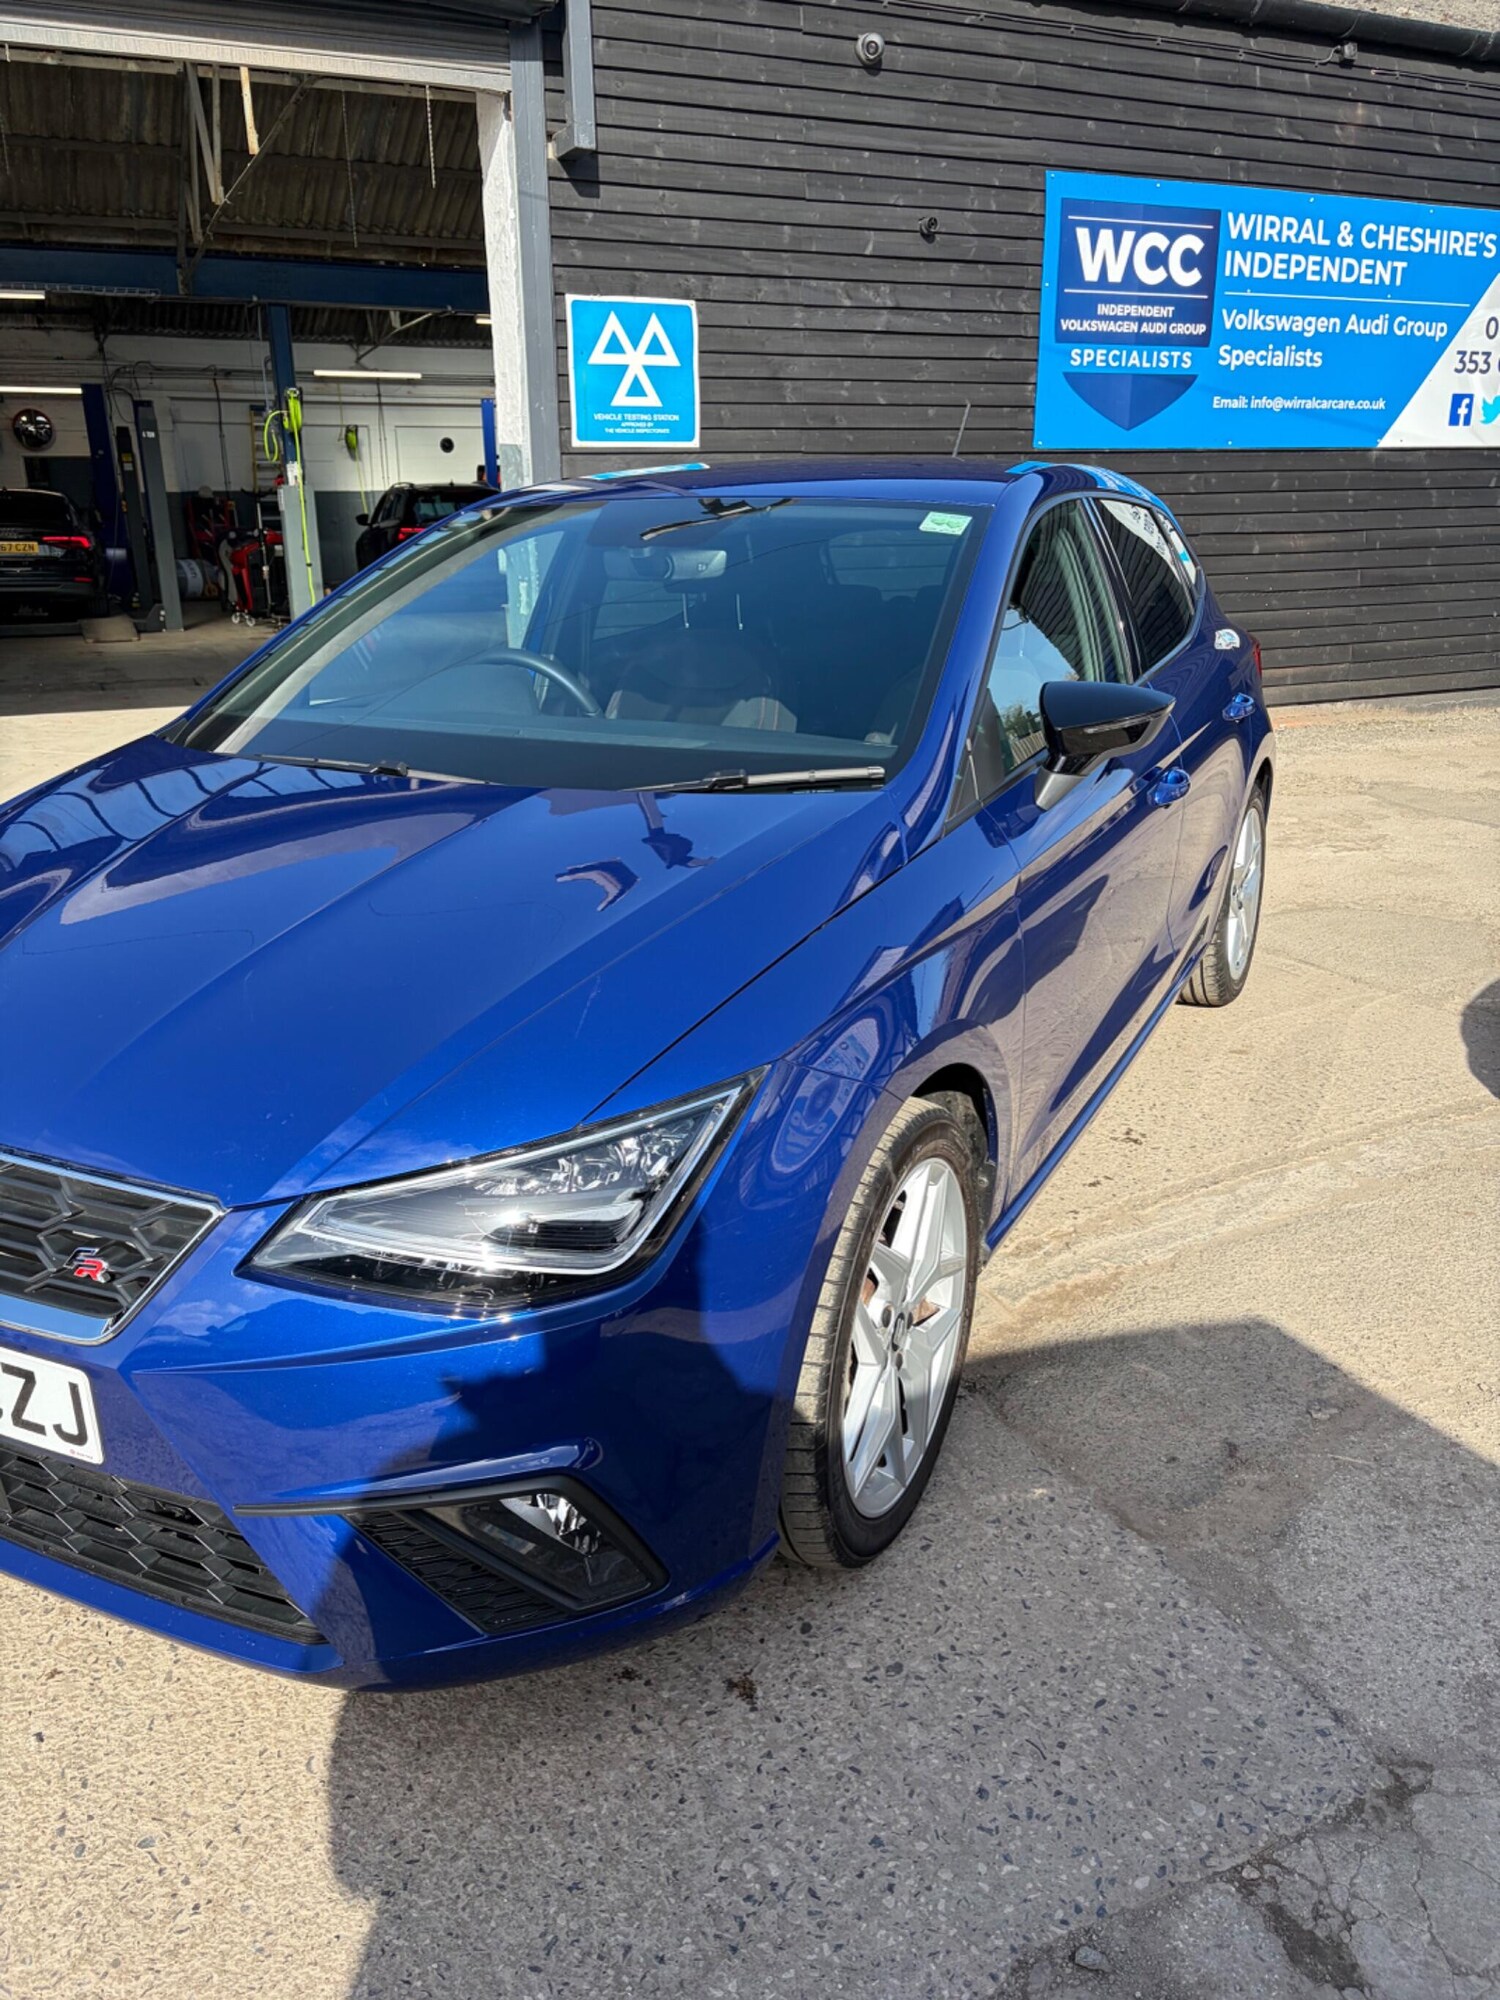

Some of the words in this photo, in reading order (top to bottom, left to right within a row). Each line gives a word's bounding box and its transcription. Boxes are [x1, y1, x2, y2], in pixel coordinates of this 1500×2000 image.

[1227, 211, 1331, 246] WIRRAL
[1336, 221, 1354, 247] &
[1361, 222, 1498, 259] CHESHIRE'S
[1075, 226, 1205, 287] WCC
[1224, 249, 1408, 287] INDEPENDENT
[1097, 303, 1175, 318] INDEPENDENT
[1060, 319, 1138, 333] VOLKSWAGEN
[1140, 322, 1167, 334] AUDI
[1169, 323, 1207, 335] GROUP
[1221, 308, 1341, 338] Volkswagen
[1344, 313, 1390, 336] Audi
[1393, 315, 1448, 342] Group
[1070, 348, 1192, 368] SPECIALISTS
[1218, 343, 1323, 371] Specialists
[1453, 350, 1492, 374] 353
[1212, 395, 1248, 409] Email:
[1250, 394, 1386, 412] info@wirralcarcare.co.uk
[593, 413, 622, 421] VEHICLE
[0, 1362, 88, 1447] ZJ
